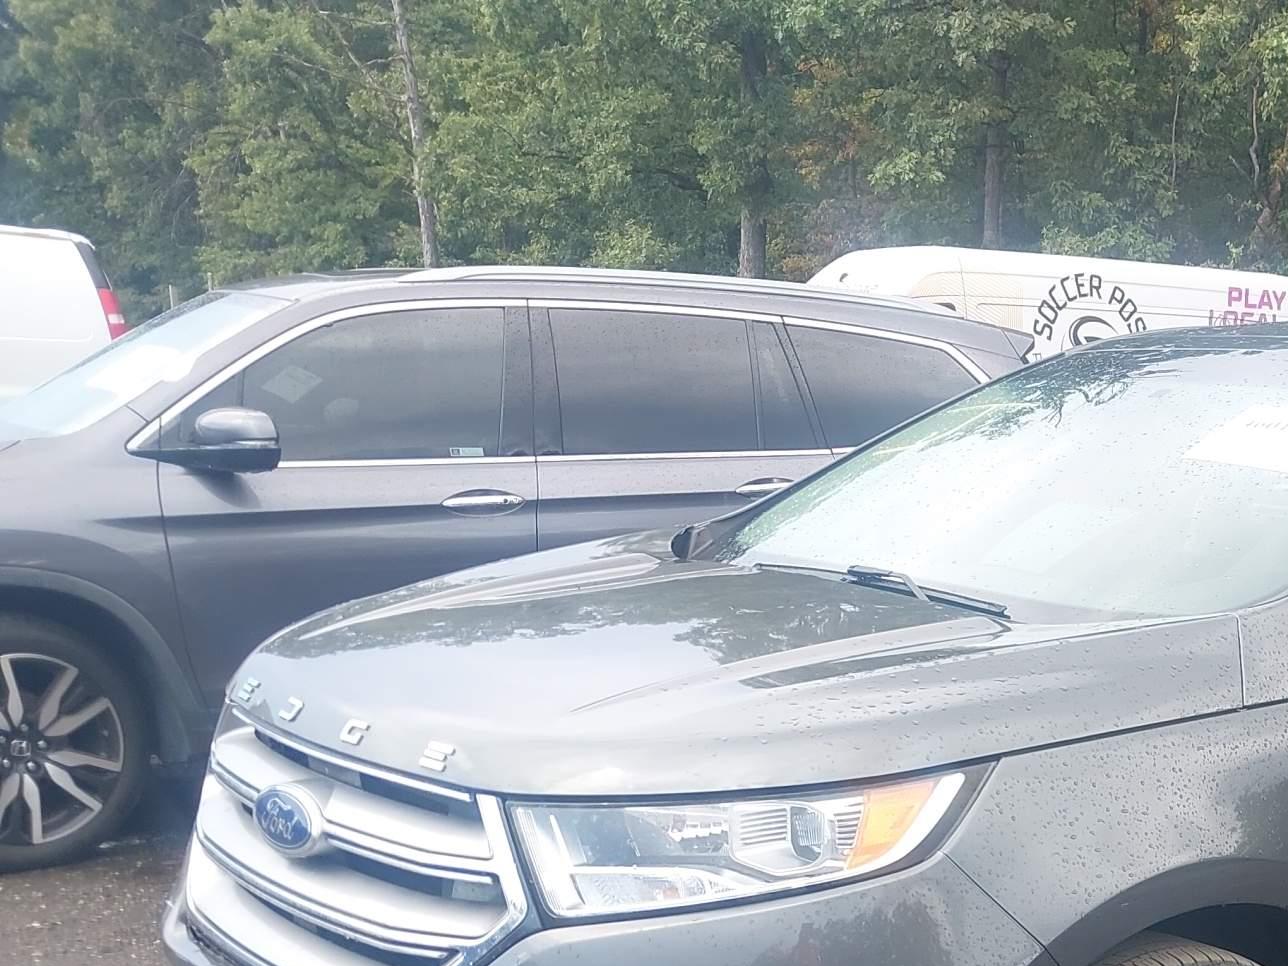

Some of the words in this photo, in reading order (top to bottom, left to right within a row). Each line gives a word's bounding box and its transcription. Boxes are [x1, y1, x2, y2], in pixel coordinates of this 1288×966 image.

[1033, 272, 1102, 341] SOCCER
[1228, 286, 1286, 311] PLAY
[261, 797, 301, 841] Ford
